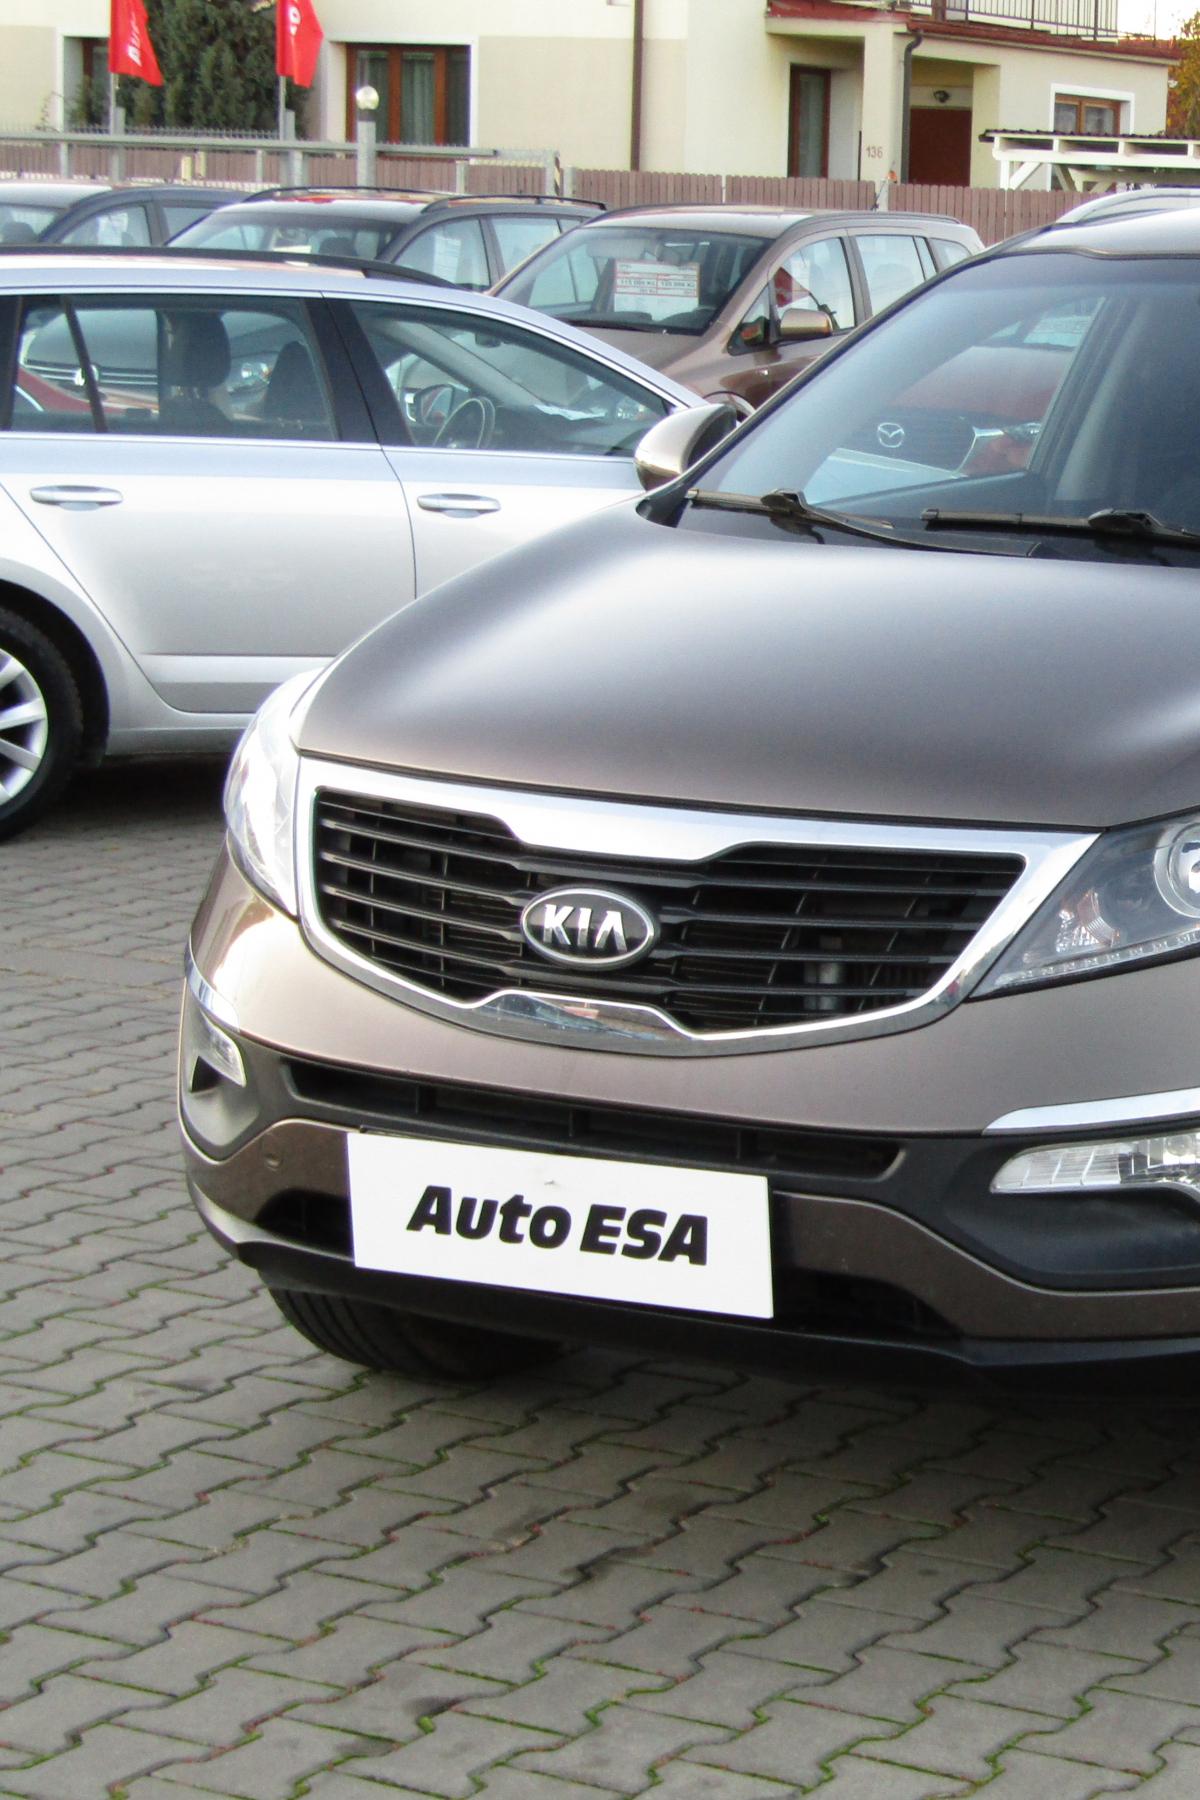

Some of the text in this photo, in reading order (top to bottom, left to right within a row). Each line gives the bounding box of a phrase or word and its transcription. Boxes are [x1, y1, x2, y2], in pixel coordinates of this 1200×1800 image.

[866, 146, 883, 158] 136
[543, 904, 628, 952] KIA
[406, 1185, 708, 1266] Auto ESA
